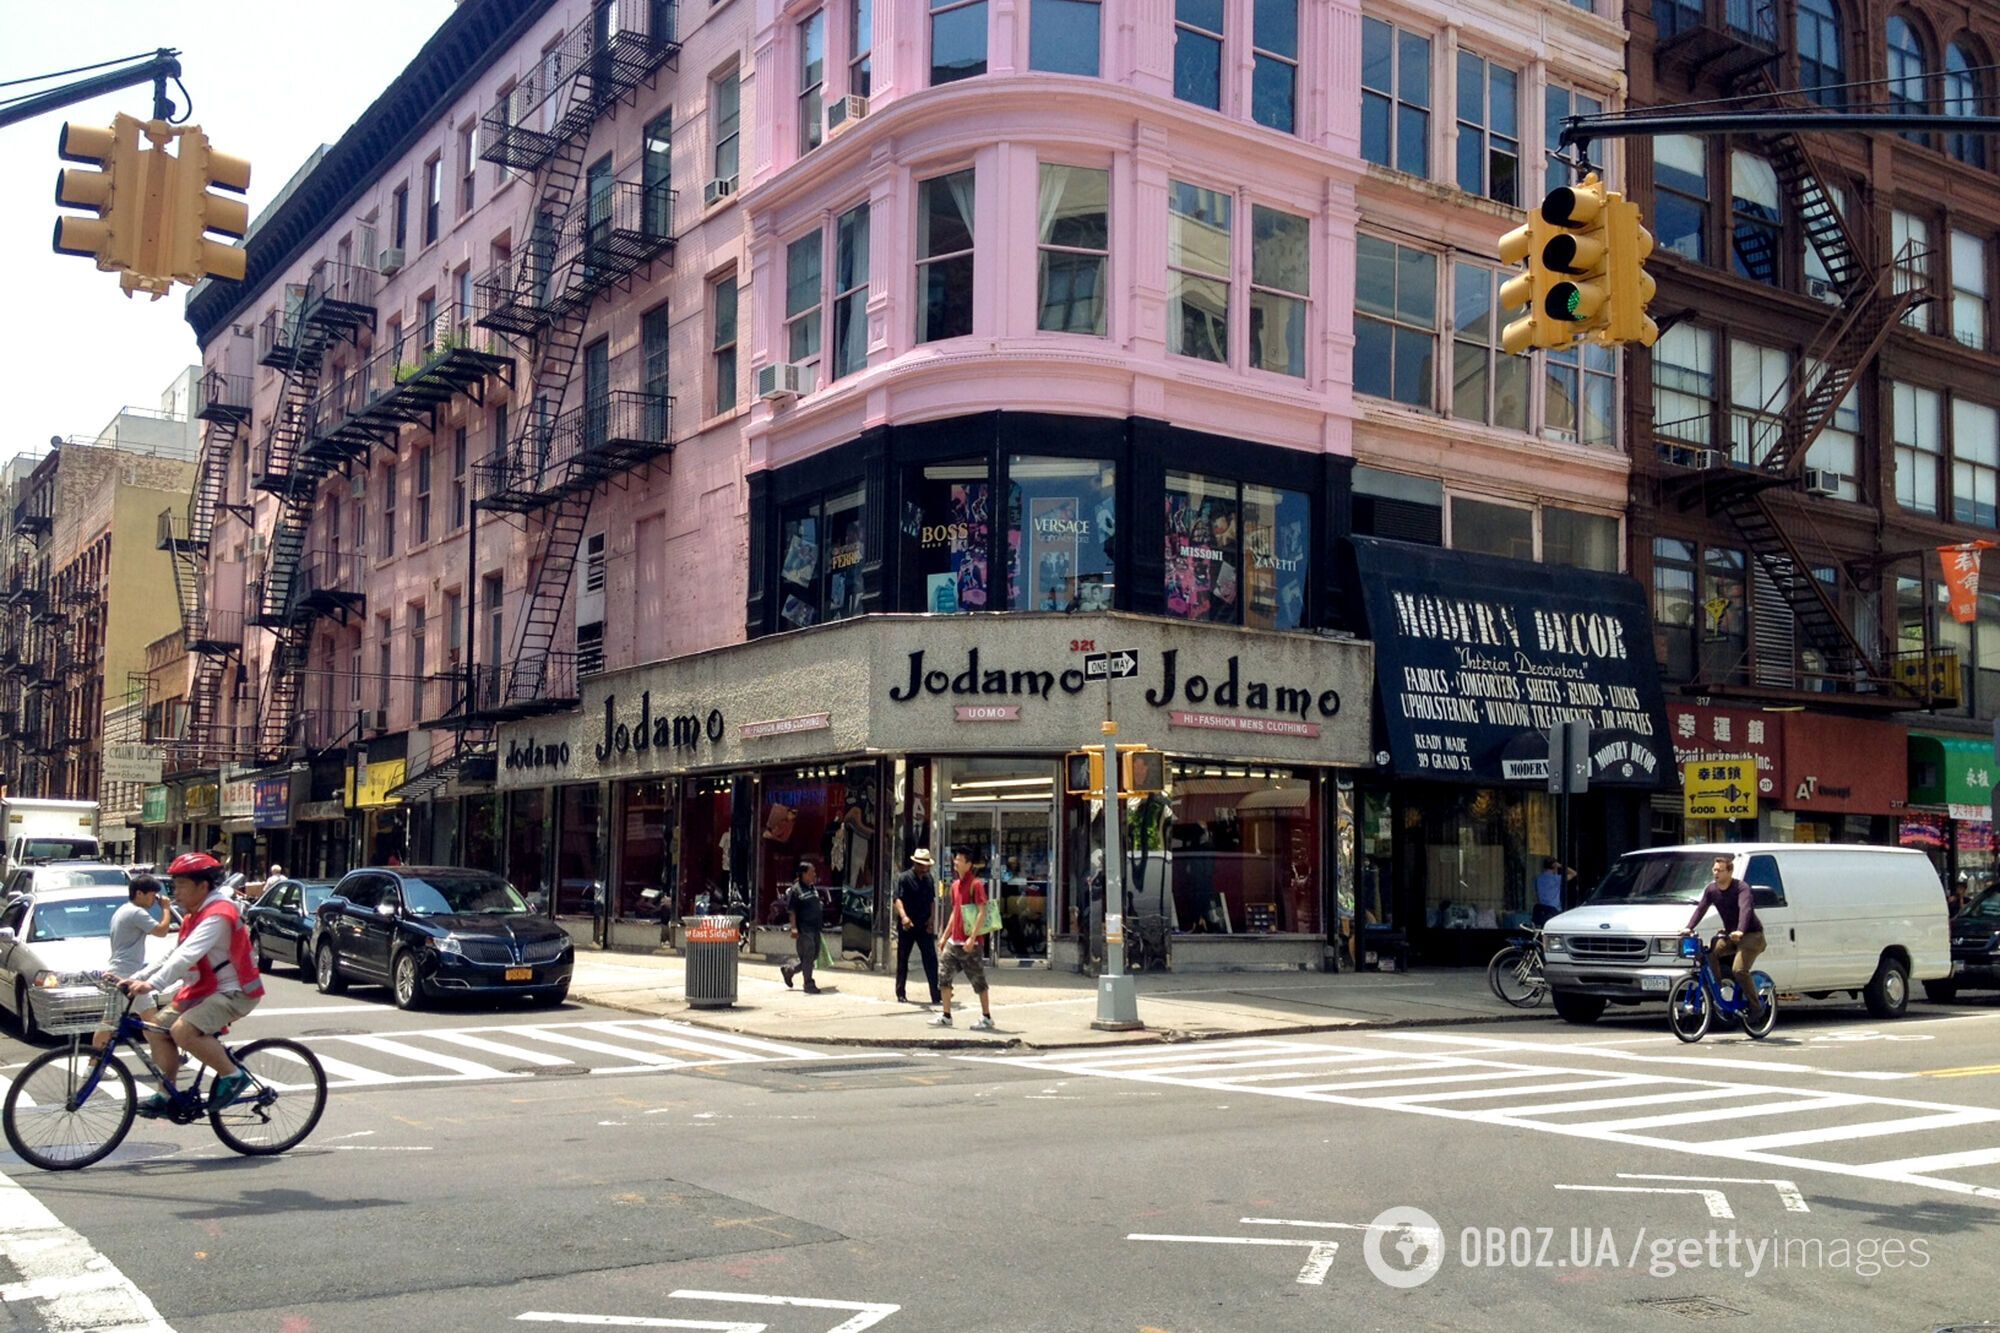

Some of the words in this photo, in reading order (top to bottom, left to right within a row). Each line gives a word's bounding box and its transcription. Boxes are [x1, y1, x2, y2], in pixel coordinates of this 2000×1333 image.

[921, 523, 969, 543] BOSS
[1034, 518, 1090, 534] VERSACE
[1180, 546, 1223, 561] MISSONI
[1255, 556, 1297, 572] ZANETTI
[1393, 591, 1521, 648] MODERN
[1534, 609, 1627, 660] DECOR
[889, 647, 1085, 702] Jodamo
[1092, 660, 1107, 673] ONE
[1112, 659, 1130, 671] WAY
[1145, 649, 1341, 721] Jodamo
[1404, 666, 1449, 694] FABRICS
[1456, 671, 1520, 700] COMFORTERS
[1526, 678, 1562, 704] SHEETS
[1567, 682, 1604, 707] BLINDS
[1608, 685, 1640, 710] LINENS
[1696, 695, 1711, 706] 317
[968, 707, 1007, 719] UOMO
[1401, 693, 1479, 723] UPHOLSTERING
[1485, 700, 1530, 728] WINDOW
[1601, 709, 1654, 736] DRAPERIES
[596, 690, 725, 762] Jodamo
[776, 720, 792, 732] MENS
[793, 716, 821, 729] CLOTHING
[1239, 719, 1264, 730] MENS
[1266, 721, 1309, 733] CLOTHING
[1414, 733, 1442, 750] READY
[1445, 736, 1468, 752] MADE
[505, 738, 570, 771] Jodamo
[1416, 752, 1430, 768] 319
[1431, 753, 1460, 770] GRAND
[1595, 741, 1628, 772] MODERN
[1631, 742, 1657, 775] DECOR
[1755, 752, 1774, 770] Inc.
[1509, 762, 1549, 777] MODERN
[1760, 780, 1772, 791] 317
[1690, 805, 1716, 814] GOOD
[1724, 805, 1749, 813] LOCK
[692, 929, 707, 938] East
